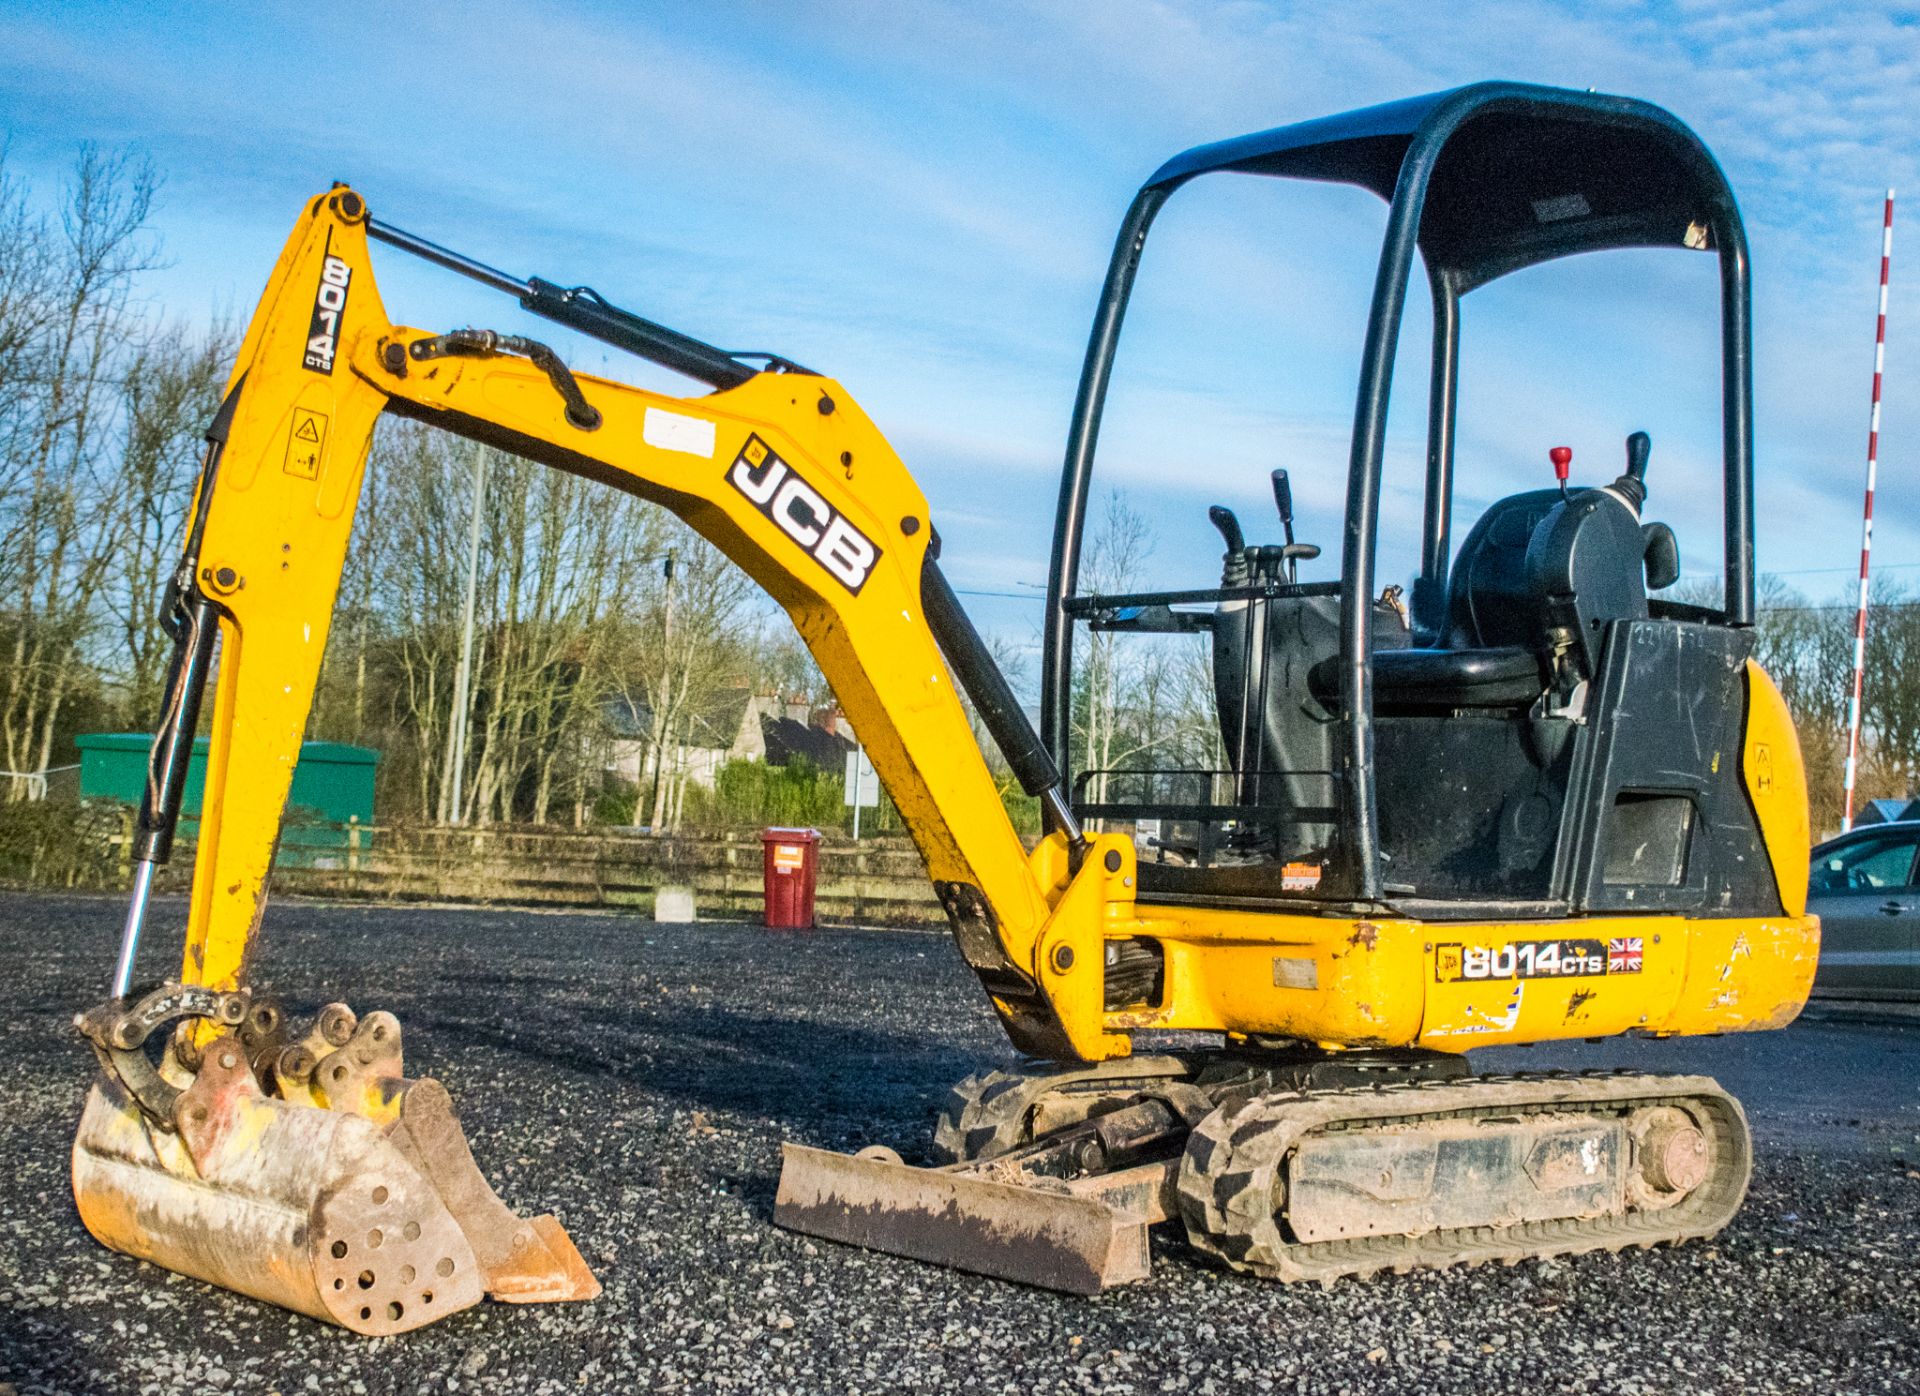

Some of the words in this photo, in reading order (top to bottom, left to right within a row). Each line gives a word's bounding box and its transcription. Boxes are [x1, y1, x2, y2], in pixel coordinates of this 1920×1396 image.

[308, 255, 351, 361] 8014
[305, 354, 332, 371] CTS
[732, 459, 875, 588] JCB
[1463, 944, 1562, 978] 8014
[1560, 956, 1603, 974] CTS
